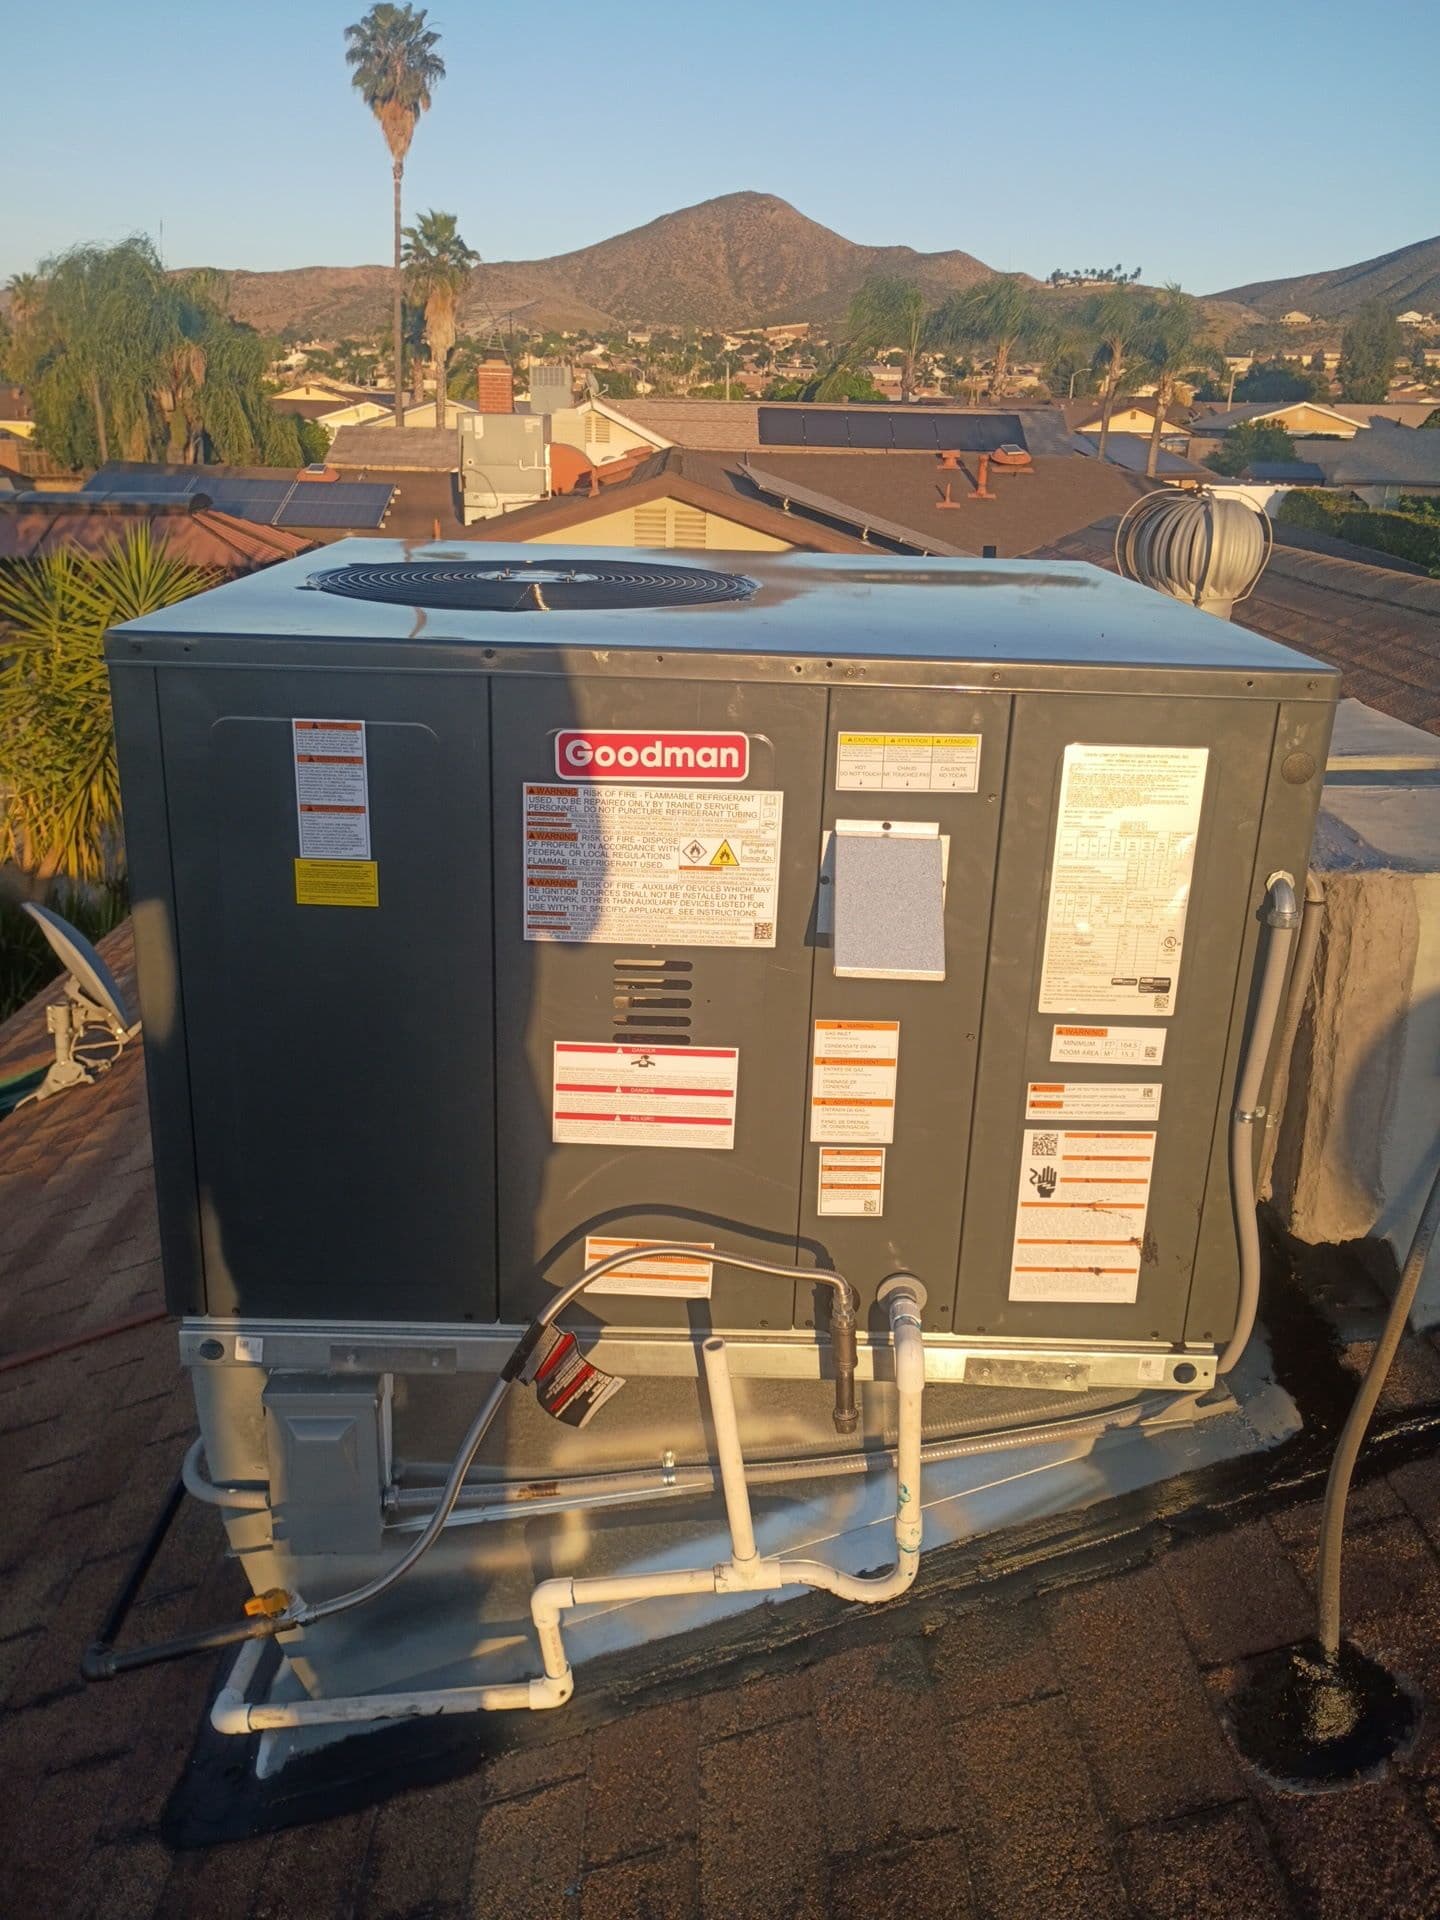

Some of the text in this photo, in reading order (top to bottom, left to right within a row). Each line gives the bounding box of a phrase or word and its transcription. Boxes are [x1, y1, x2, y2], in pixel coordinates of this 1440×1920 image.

[565, 739, 740, 769] Goodman
[537, 787, 577, 796] WARNING
[583, 789, 601, 797] RISK
[619, 791, 638, 799] FIRE
[644, 792, 695, 801] FLAMMABLE
[696, 793, 755, 802] REFRIGERANT
[584, 798, 626, 807] REPAIRED
[628, 800, 651, 808] ONLY
[666, 801, 702, 809] TRAINED
[703, 802, 740, 810] SERVICE
[666, 808, 726, 817] REFRIGERANT
[537, 832, 578, 841] WARNING
[643, 836, 679, 845] DISPOSE
[541, 841, 585, 849] PROPERLY
[598, 843, 656, 851] ACCORDANCE
[742, 840, 775, 848] Refrigerant
[583, 850, 610, 858] LOCAL
[528, 857, 578, 866] FLAMMABLE
[579, 858, 638, 867] REFRIGERANT
[642, 883, 683, 891] AUXILIARY
[580, 889, 621, 897] SOURCES
[623, 889, 648, 897] SHALL
[636, 898, 678, 906] AUXILIARY
